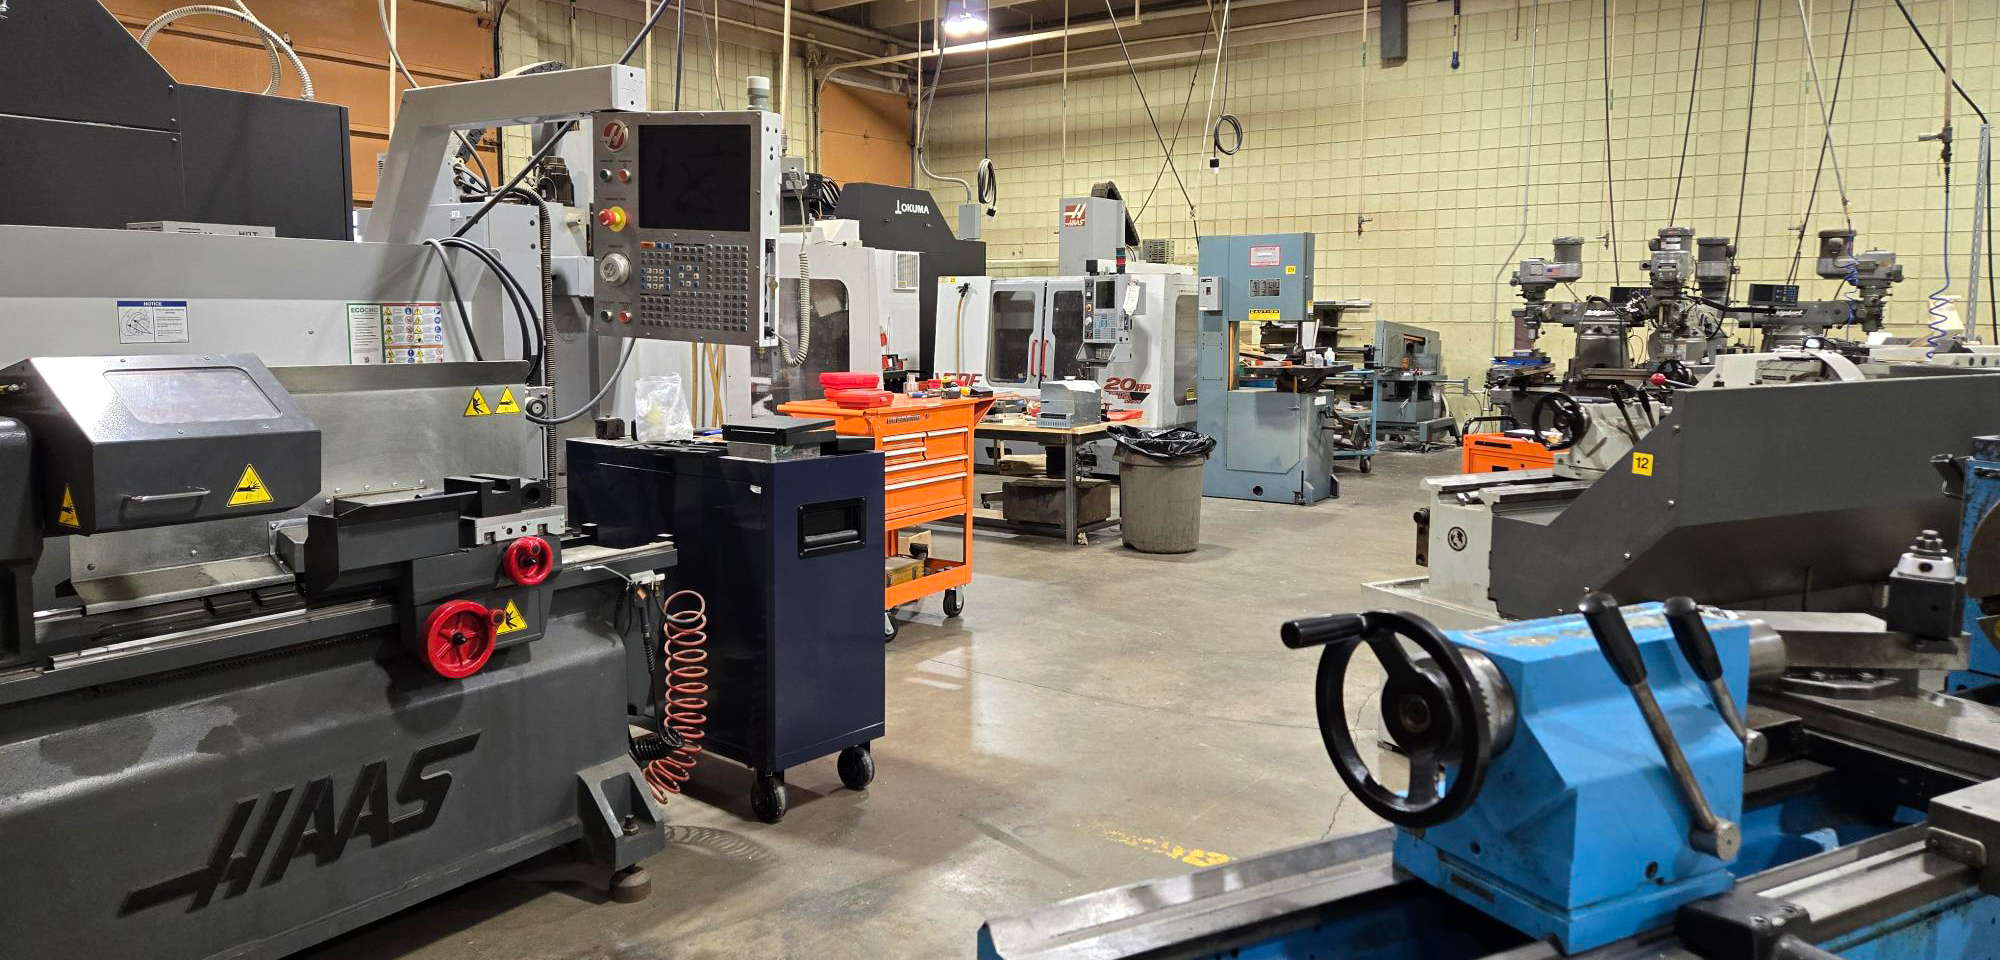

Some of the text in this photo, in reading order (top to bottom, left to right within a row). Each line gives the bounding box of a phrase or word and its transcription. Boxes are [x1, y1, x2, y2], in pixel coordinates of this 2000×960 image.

[900, 202, 930, 215] OKUMA
[1635, 456, 1649, 469] 12
[116, 728, 482, 919] HAAS
